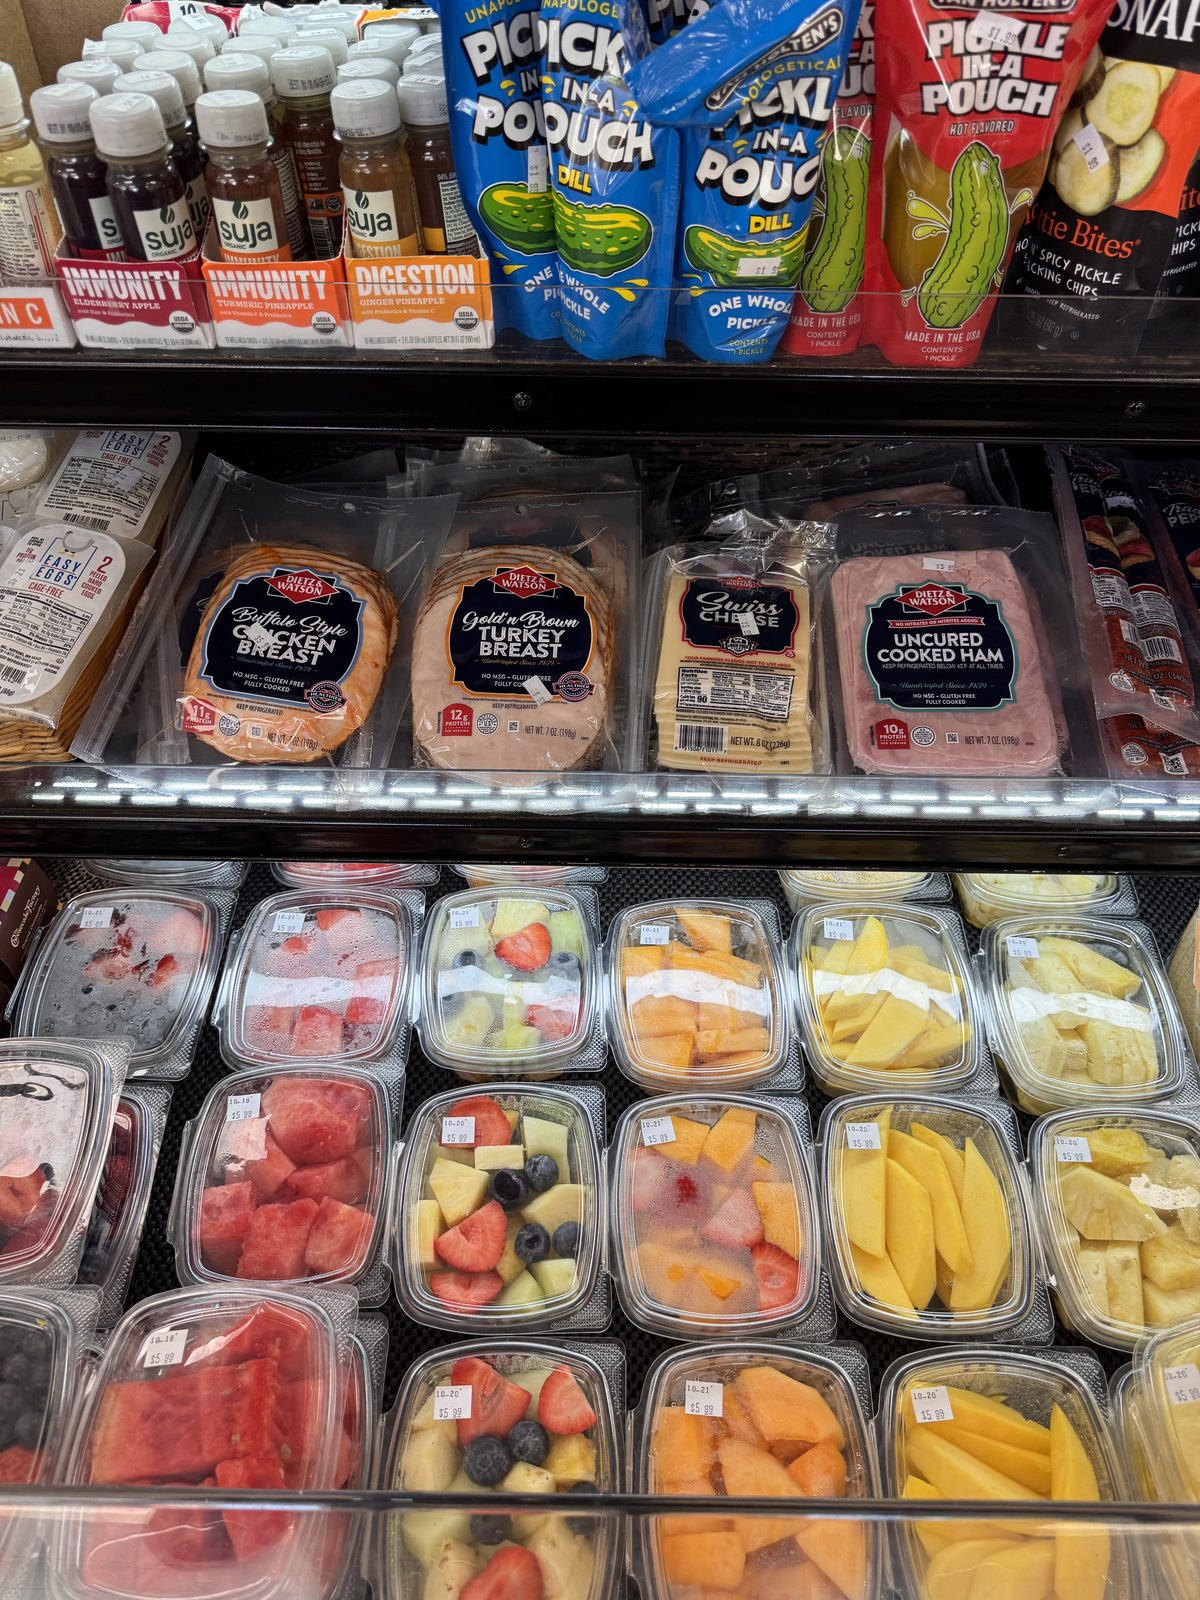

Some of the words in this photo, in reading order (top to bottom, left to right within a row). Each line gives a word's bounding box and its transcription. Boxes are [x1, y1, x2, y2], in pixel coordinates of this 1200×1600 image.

[562, 78, 615, 112] IN-A
[921, 82, 1059, 116] POUCH
[543, 101, 653, 163] OUCH
[949, 122, 969, 135] HOT
[970, 120, 1014, 134] FLAVORED
[753, 129, 807, 154] IN-A
[558, 164, 592, 191] DILL
[750, 213, 792, 234] DILL
[145, 219, 194, 250] suja
[220, 220, 273, 248] suja
[1070, 219, 1134, 258] Bites
[224, 241, 247, 250] ORGANIC
[1171, 239, 1195, 256] HIPS
[151, 249, 178, 258] ORGANIC
[1040, 250, 1070, 271] SPICY
[1074, 263, 1122, 285] PICKLE
[62, 267, 182, 300] IMMUNITY
[208, 270, 326, 300] IMMUNITY
[355, 264, 475, 297] DIGESTION
[524, 265, 554, 293] ONE
[566, 275, 610, 314] WHOLE
[1066, 278, 1098, 301] CHIPS
[73, 299, 130, 309] ELDERBERRY
[132, 302, 161, 310] APPLE
[217, 299, 263, 309] TURMERIC
[265, 302, 315, 310] PINEAPPLE
[395, 297, 445, 305] PINEAPPLE
[709, 296, 742, 317] ONE
[747, 295, 793, 314] WHOL
[25, 302, 42, 325] C
[1060, 302, 1099, 320] REFRIGERATED
[818, 316, 828, 328] IN
[831, 315, 846, 327] THE
[904, 331, 934, 343] MADE
[937, 331, 947, 343] IN
[951, 331, 965, 342] THE
[966, 329, 981, 341] USA
[921, 346, 963, 354] CONTENTS
[111, 431, 147, 447] EASY
[158, 434, 171, 449] 2
[105, 440, 142, 457] EGGS
[101, 452, 134, 465] CAGE-FREE
[43, 554, 82, 573] EASY
[96, 556, 113, 574] 2
[35, 566, 74, 586] EGGS
[87, 576, 103, 587] HARD
[89, 570, 108, 582] PEELED
[286, 575, 315, 587] DIETZ
[315, 579, 323, 588] &
[509, 573, 538, 582] DIETZ
[28, 582, 65, 599] CAGE-FREE
[80, 581, 103, 595] COOKED
[277, 581, 323, 596] WATSON
[502, 579, 547, 590] WATSON
[80, 589, 96, 600] EGGS
[909, 597, 956, 606] WATSON
[915, 590, 945, 599] DIETZ
[945, 591, 953, 599] &
[697, 591, 784, 616] Swiss
[232, 607, 298, 628] Buffalo
[299, 616, 348, 638] Style
[462, 611, 517, 631] Gold'n
[519, 610, 580, 628] Brown
[700, 611, 780, 628] CHESE
[479, 626, 566, 643] TURKEY
[894, 633, 983, 647] UNCURED
[236, 641, 324, 666] BREAST
[479, 641, 563, 659] BREAST
[877, 649, 956, 662] COOKED
[960, 649, 1005, 662] HAM
[232, 670, 244, 678] NO
[263, 675, 289, 685] GLUTEN
[289, 679, 305, 688] FREE
[244, 680, 262, 688] FULLY
[263, 682, 291, 694] COOKED
[697, 695, 707, 703] 90
[236, 703, 248, 711] KEEP
[249, 704, 284, 716] REFRIGERATED
[525, 725, 535, 735] NET
[535, 726, 545, 736] WT.
[550, 728, 559, 737] OZ.
[559, 728, 577, 740] (198g)
[730, 736, 743, 746] NET
[743, 738, 755, 747] WT.
[756, 738, 761, 747] 8
[965, 736, 975, 745] NET
[975, 736, 986, 745] WT.
[992, 736, 1001, 745] OZ.
[1002, 736, 1020, 746] (198g)
[717, 757, 762, 766] REFRIGERATED
[447, 1133, 456, 1142] $5
[853, 1139, 861, 1148] $5
[1062, 1152, 1071, 1161] $5
[687, 1385, 709, 1394] 10-21
[913, 1391, 937, 1400] 10-20
[439, 1408, 449, 1418] $5
[690, 1401, 700, 1413] $5
[921, 1409, 932, 1420] $5
